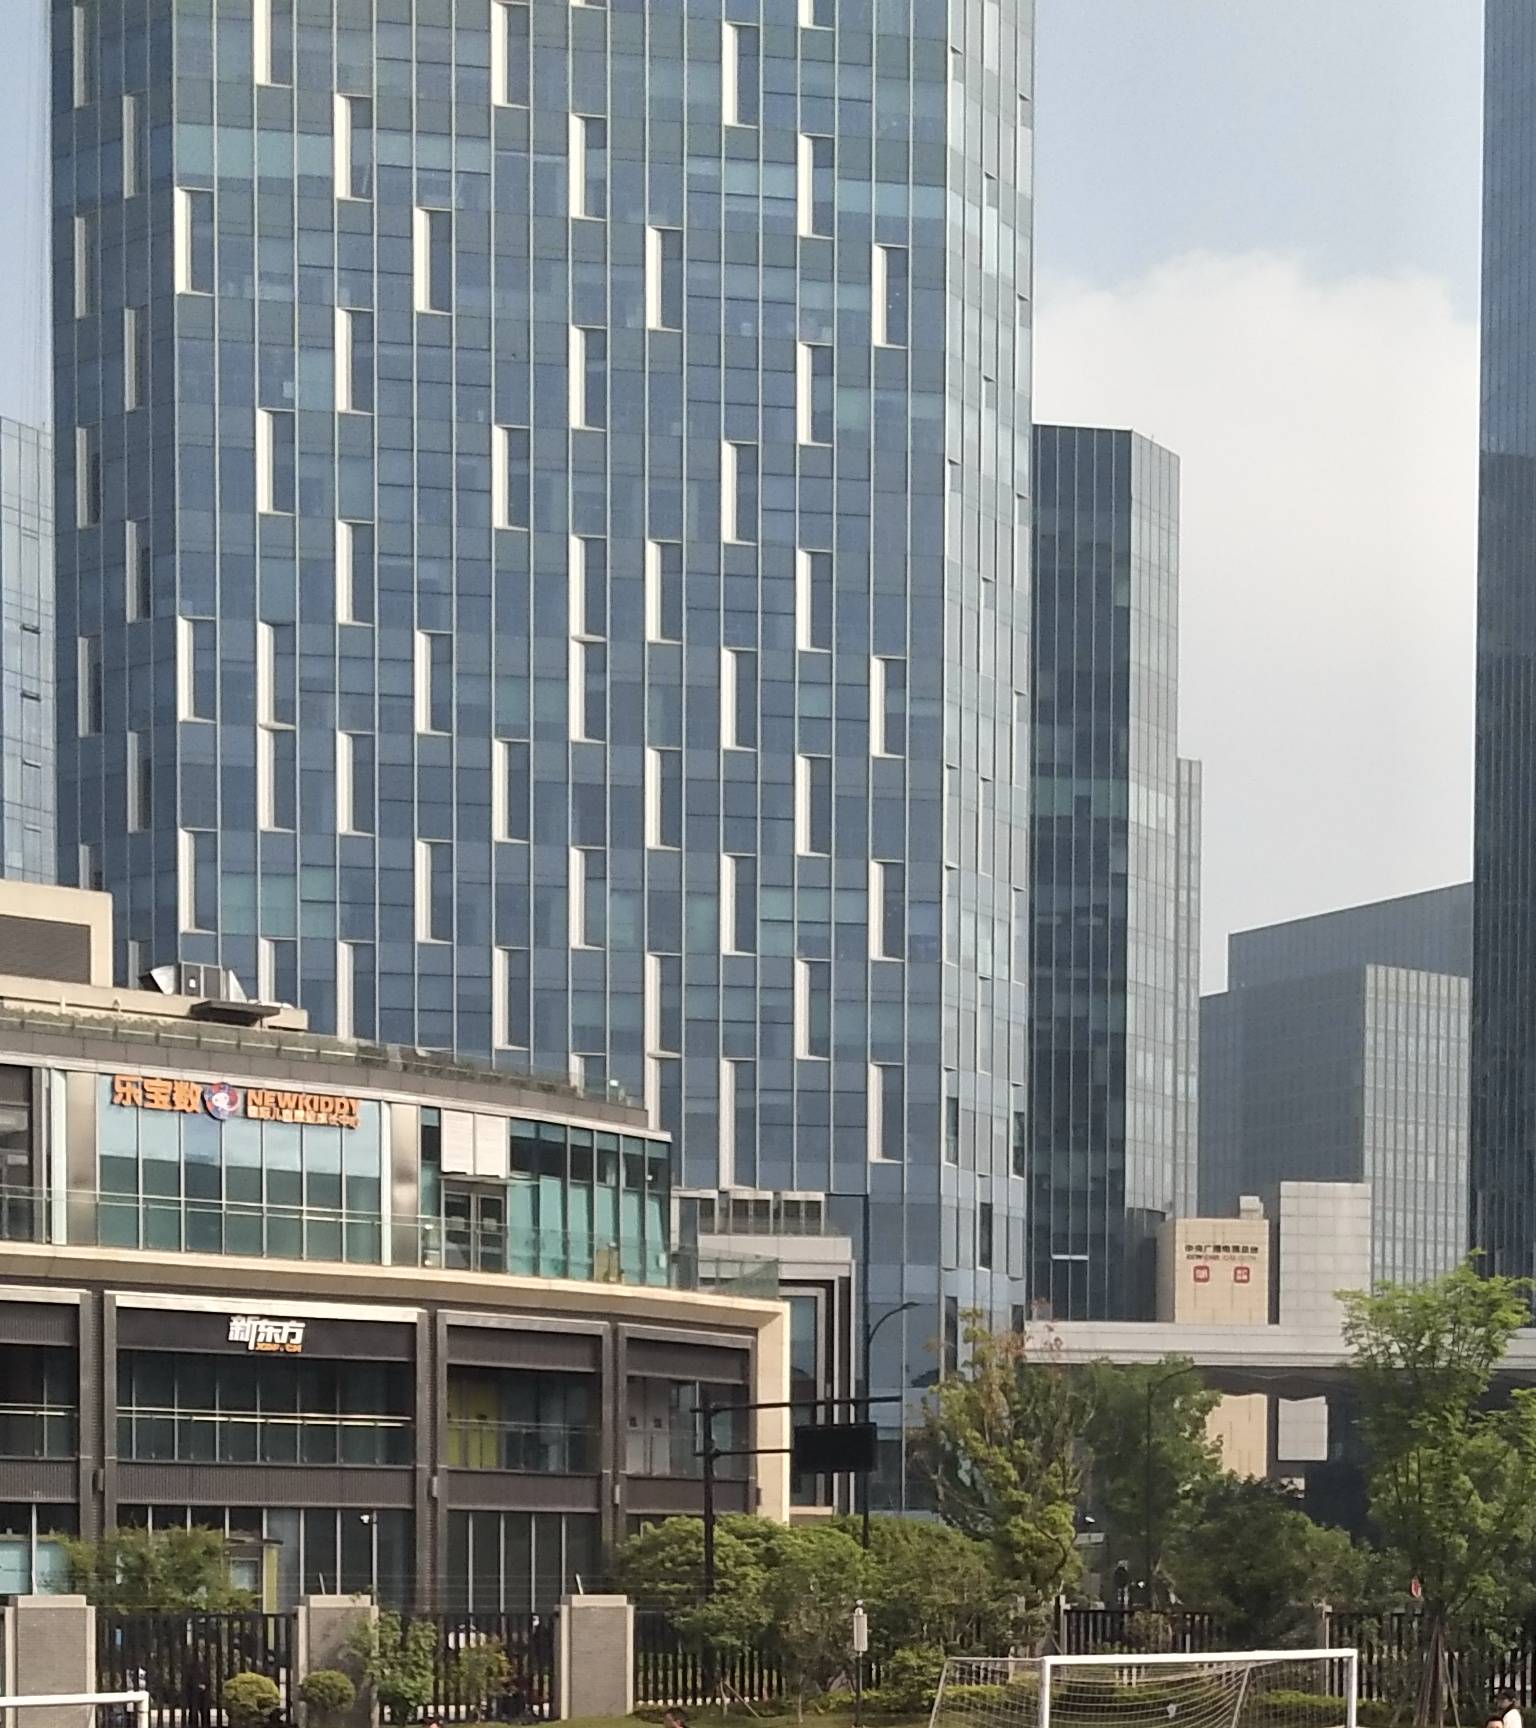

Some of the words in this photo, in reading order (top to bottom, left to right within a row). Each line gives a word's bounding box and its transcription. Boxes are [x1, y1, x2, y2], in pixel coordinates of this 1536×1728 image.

[112, 1075, 203, 1113] 乐宝数
[248, 1089, 359, 1115] NEWKIDDY
[228, 1315, 306, 1350] 新东方
